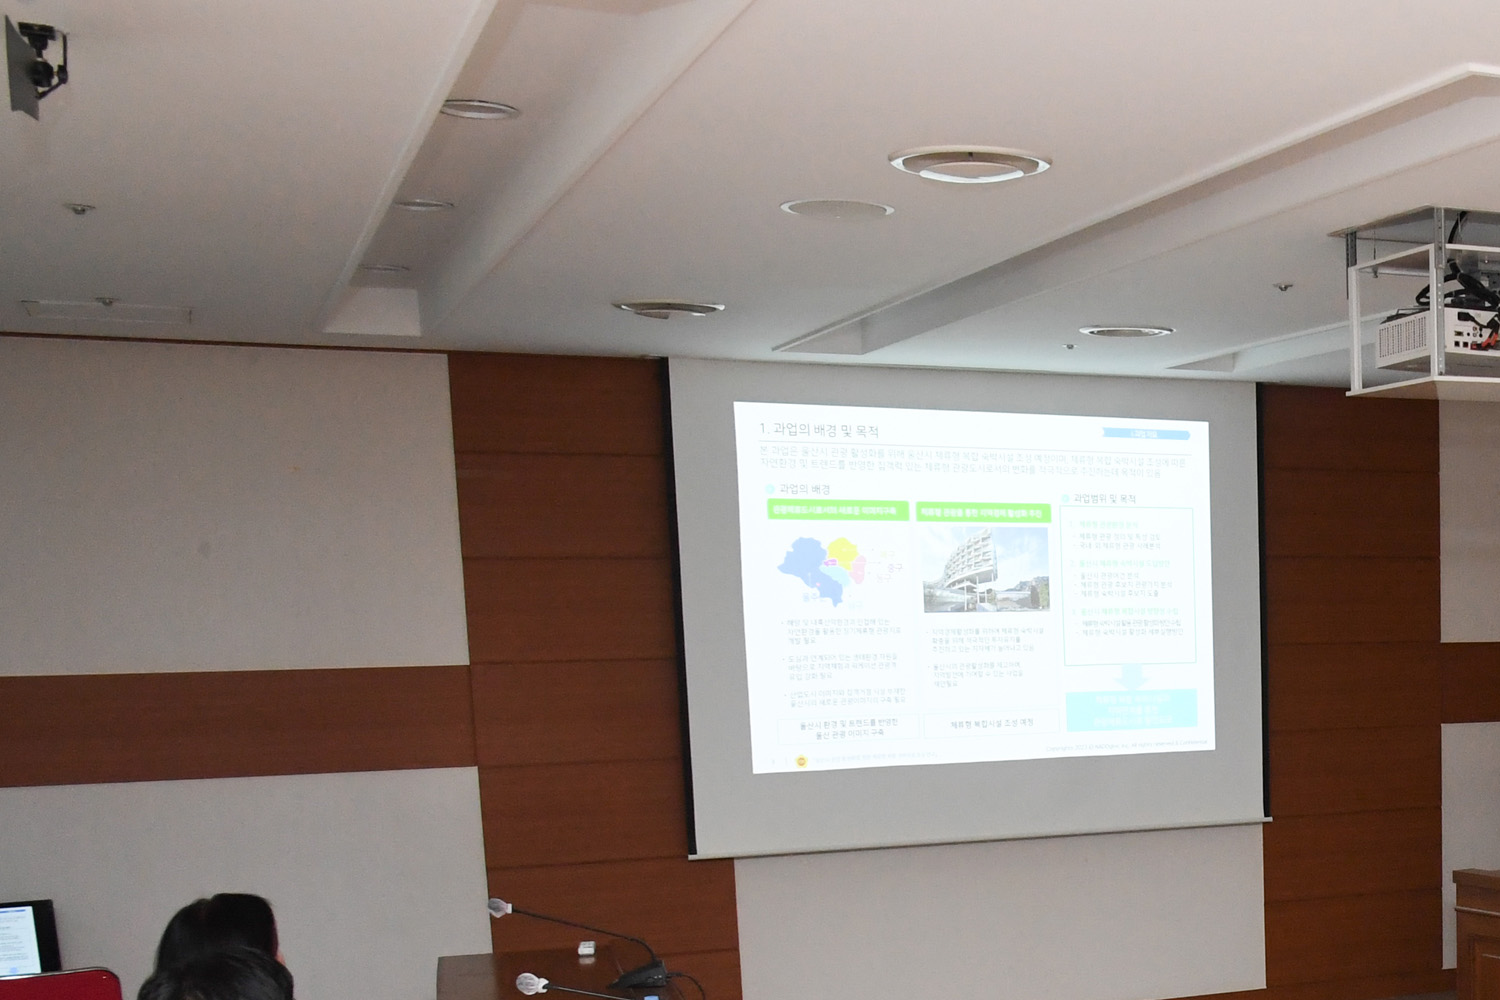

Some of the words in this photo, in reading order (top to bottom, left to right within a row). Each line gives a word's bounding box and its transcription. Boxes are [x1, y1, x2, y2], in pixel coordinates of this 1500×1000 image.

[772, 423, 810, 436] 과업의
[813, 424, 836, 437] 배경
[856, 426, 879, 438] 목적
[780, 483, 808, 494] 과업의
[811, 484, 829, 494] 배경
[1074, 493, 1106, 503] 과업범위
[1120, 494, 1135, 504] 목적
